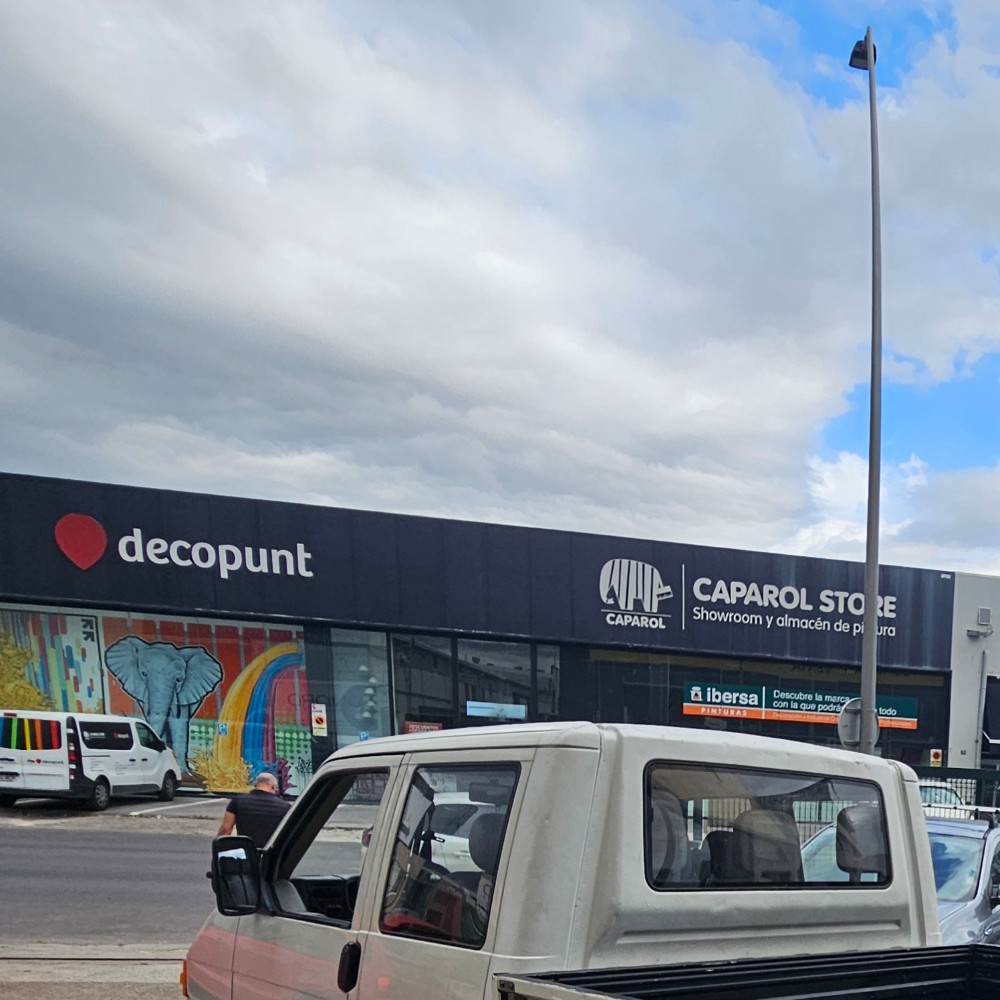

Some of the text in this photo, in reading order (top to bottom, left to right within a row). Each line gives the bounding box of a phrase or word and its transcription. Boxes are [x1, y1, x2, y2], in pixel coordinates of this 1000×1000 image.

[118, 527, 314, 579] decopunt
[693, 577, 813, 611] CAPAROL
[605, 613, 666, 629] CAPAROL
[693, 606, 896, 636] Showroom y almacén de piura
[707, 687, 759, 706] ibersa
[773, 689, 851, 703] Descubre la marca
[700, 707, 748, 717] PINTURAS
[772, 700, 897, 716] con la que podrá todo
